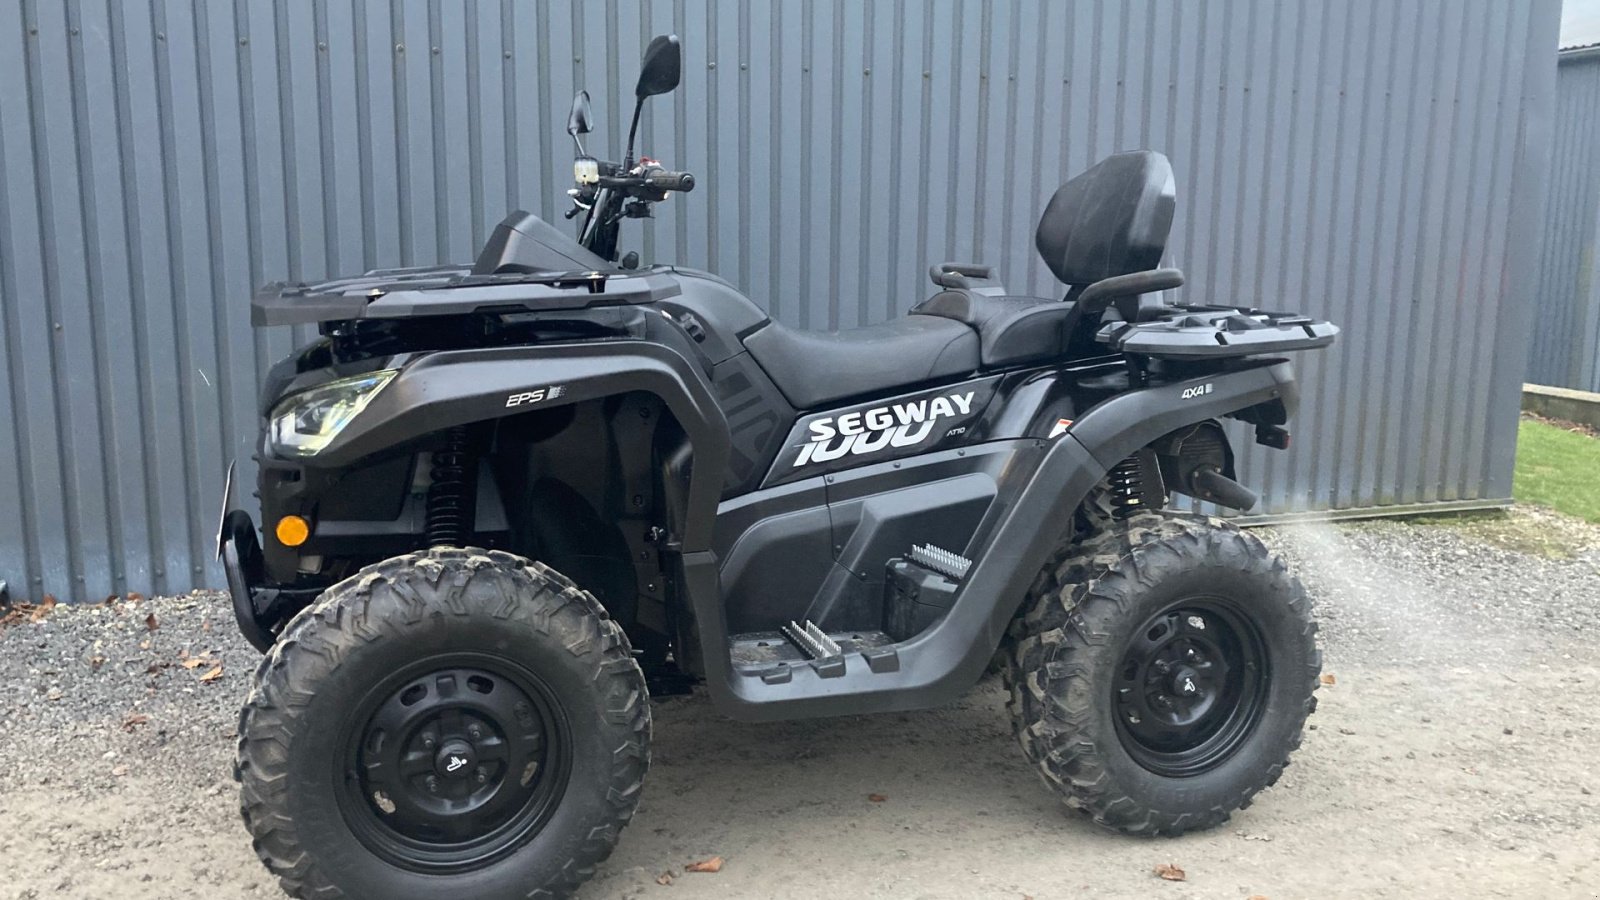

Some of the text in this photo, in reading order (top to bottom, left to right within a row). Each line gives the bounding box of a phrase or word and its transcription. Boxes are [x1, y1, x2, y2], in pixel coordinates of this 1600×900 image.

[505, 389, 545, 408] EPS
[808, 391, 975, 442] SEGWAY
[946, 426, 966, 437] AT10
